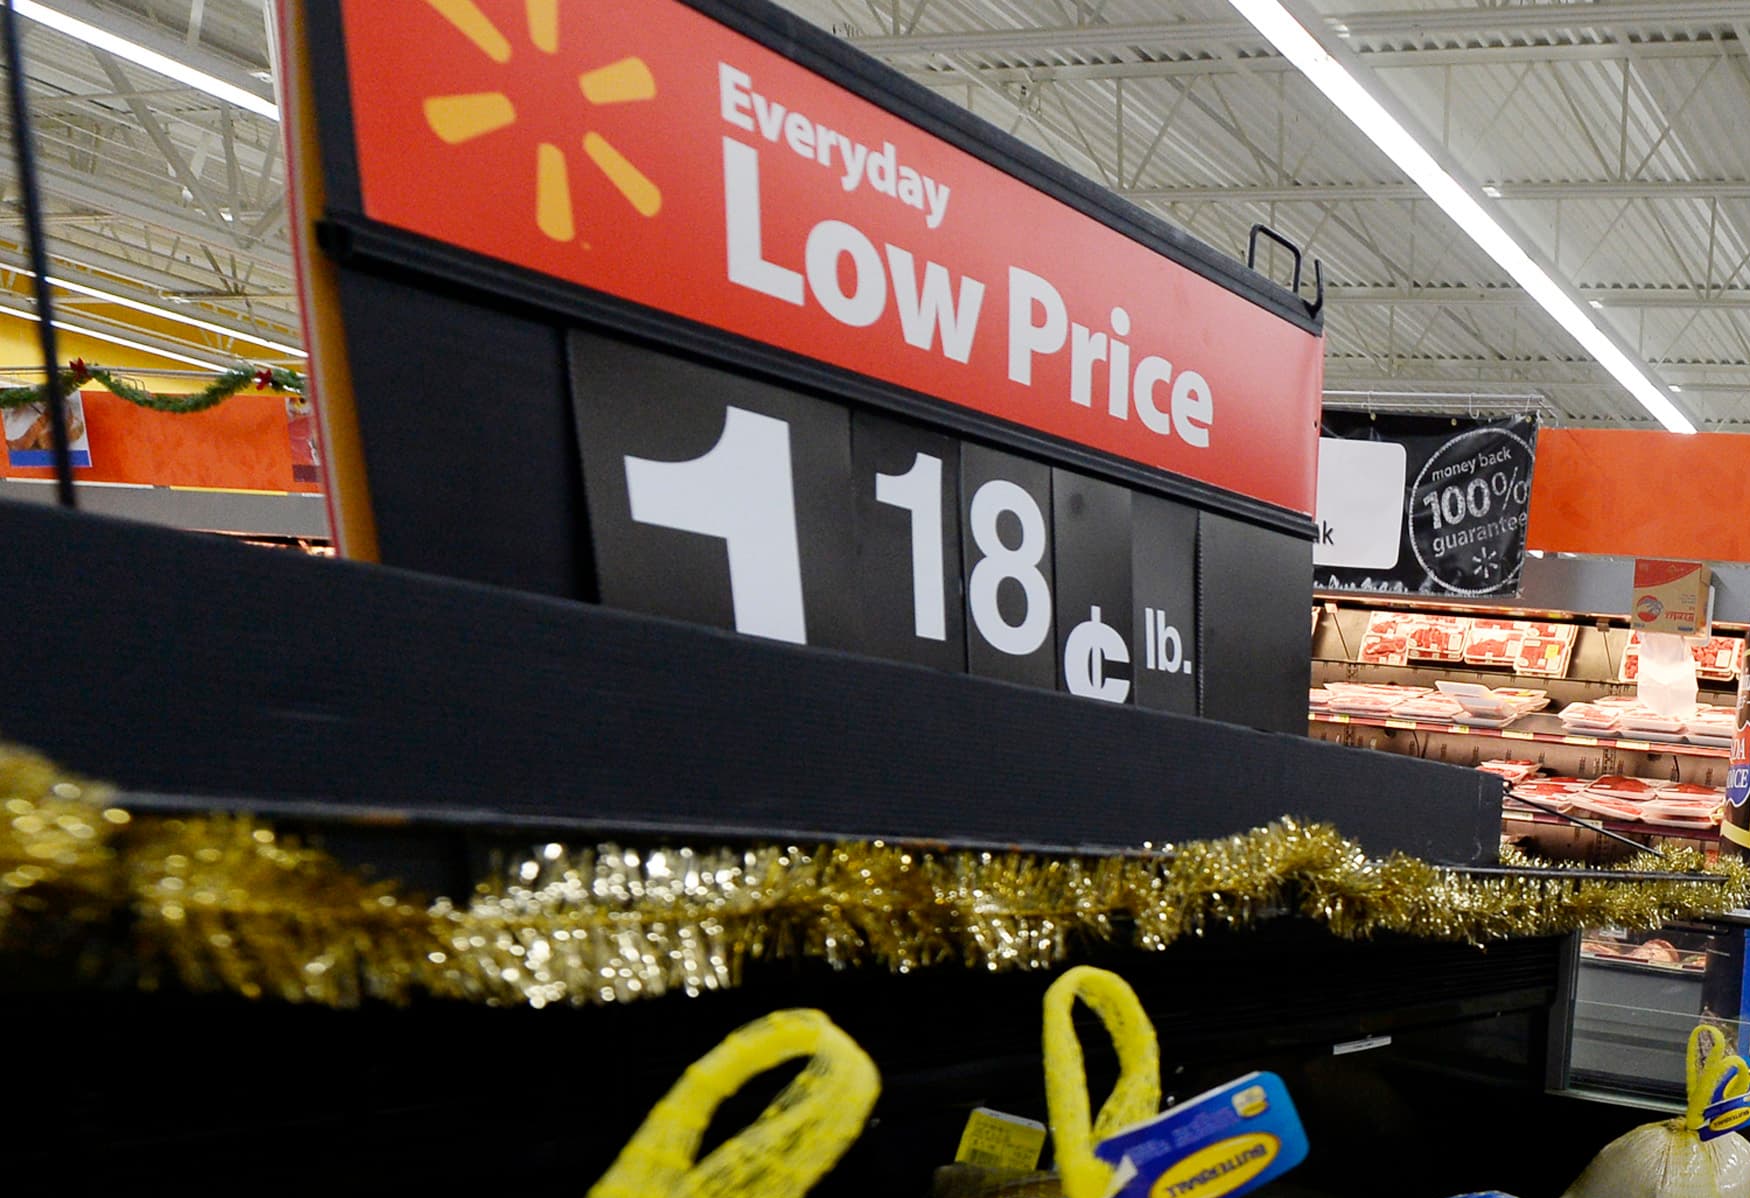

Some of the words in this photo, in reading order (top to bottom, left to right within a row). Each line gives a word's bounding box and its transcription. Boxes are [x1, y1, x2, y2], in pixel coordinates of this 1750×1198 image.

[718, 61, 951, 229] Everyday
[721, 135, 986, 365] Low
[1007, 265, 1215, 449] Price
[1431, 459, 1477, 482] money
[1478, 446, 1513, 468] back
[1422, 466, 1529, 530] 100%
[1432, 512, 1528, 558] guarantee
[1144, 607, 1193, 674] lb.
